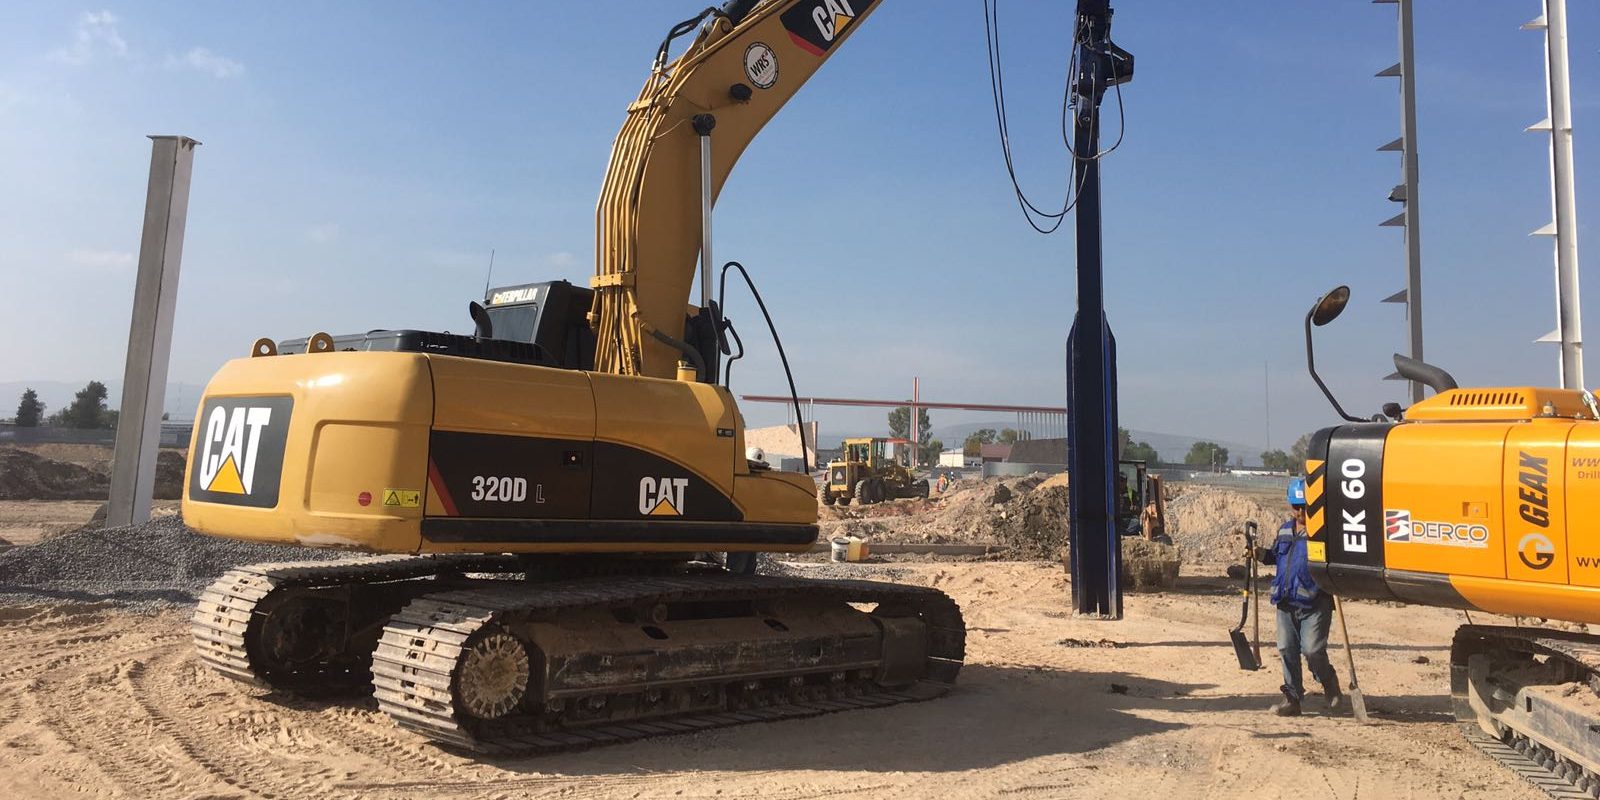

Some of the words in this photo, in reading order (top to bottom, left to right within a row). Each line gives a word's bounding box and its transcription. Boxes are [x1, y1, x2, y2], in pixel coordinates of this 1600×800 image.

[750, 54, 770, 77] WRS
[492, 287, 538, 305] CATERPILLAR
[199, 405, 272, 495] CAT
[471, 475, 527, 502] 320D
[535, 484, 546, 504] L
[639, 476, 689, 516] CAT
[1341, 458, 1366, 499] 60
[1519, 450, 1550, 528] GEAX
[1342, 508, 1368, 553] EK
[1411, 521, 1488, 542] DERCO
